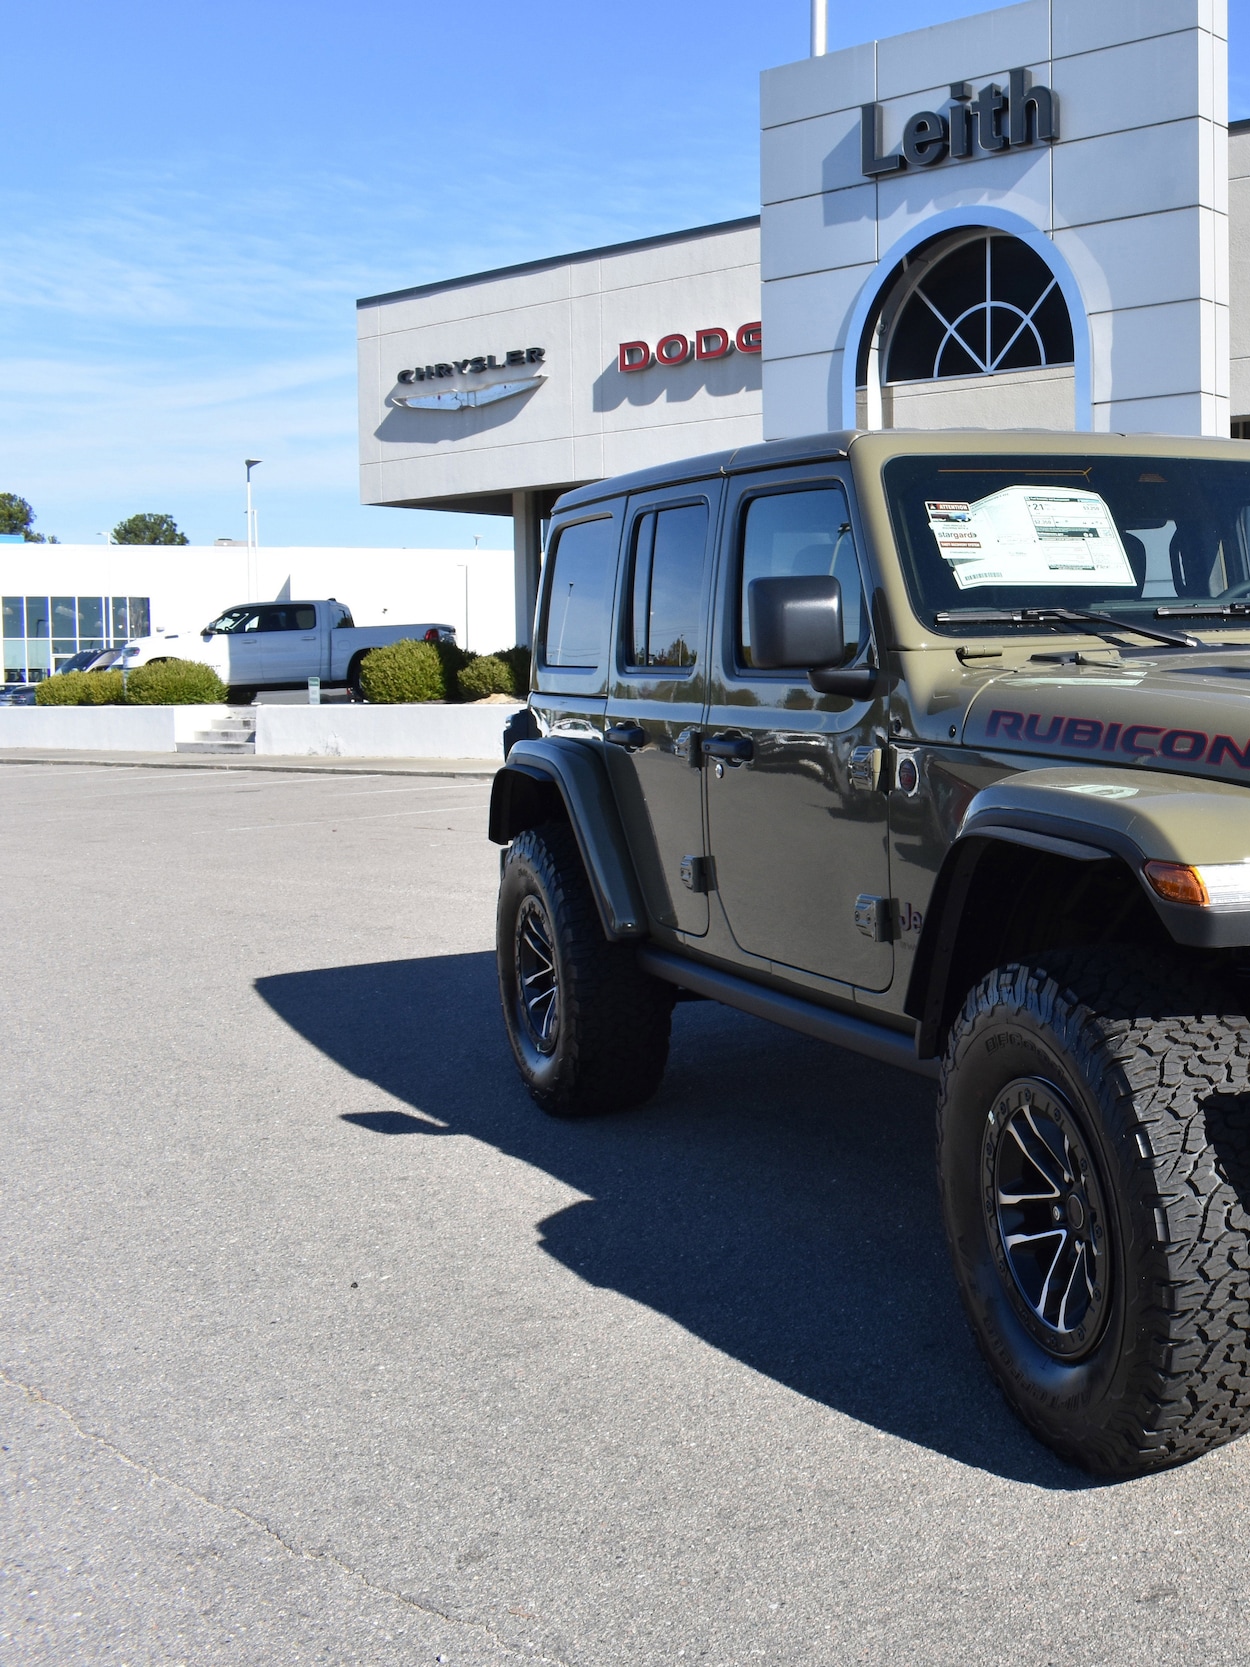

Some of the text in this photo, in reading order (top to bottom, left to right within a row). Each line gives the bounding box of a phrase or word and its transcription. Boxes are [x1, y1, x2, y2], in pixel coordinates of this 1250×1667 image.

[861, 67, 1060, 177] Leith
[618, 321, 762, 372] DODG
[397, 347, 546, 384] CHRYSLER
[1032, 503, 1045, 511] 21
[899, 902, 923, 934] Je
